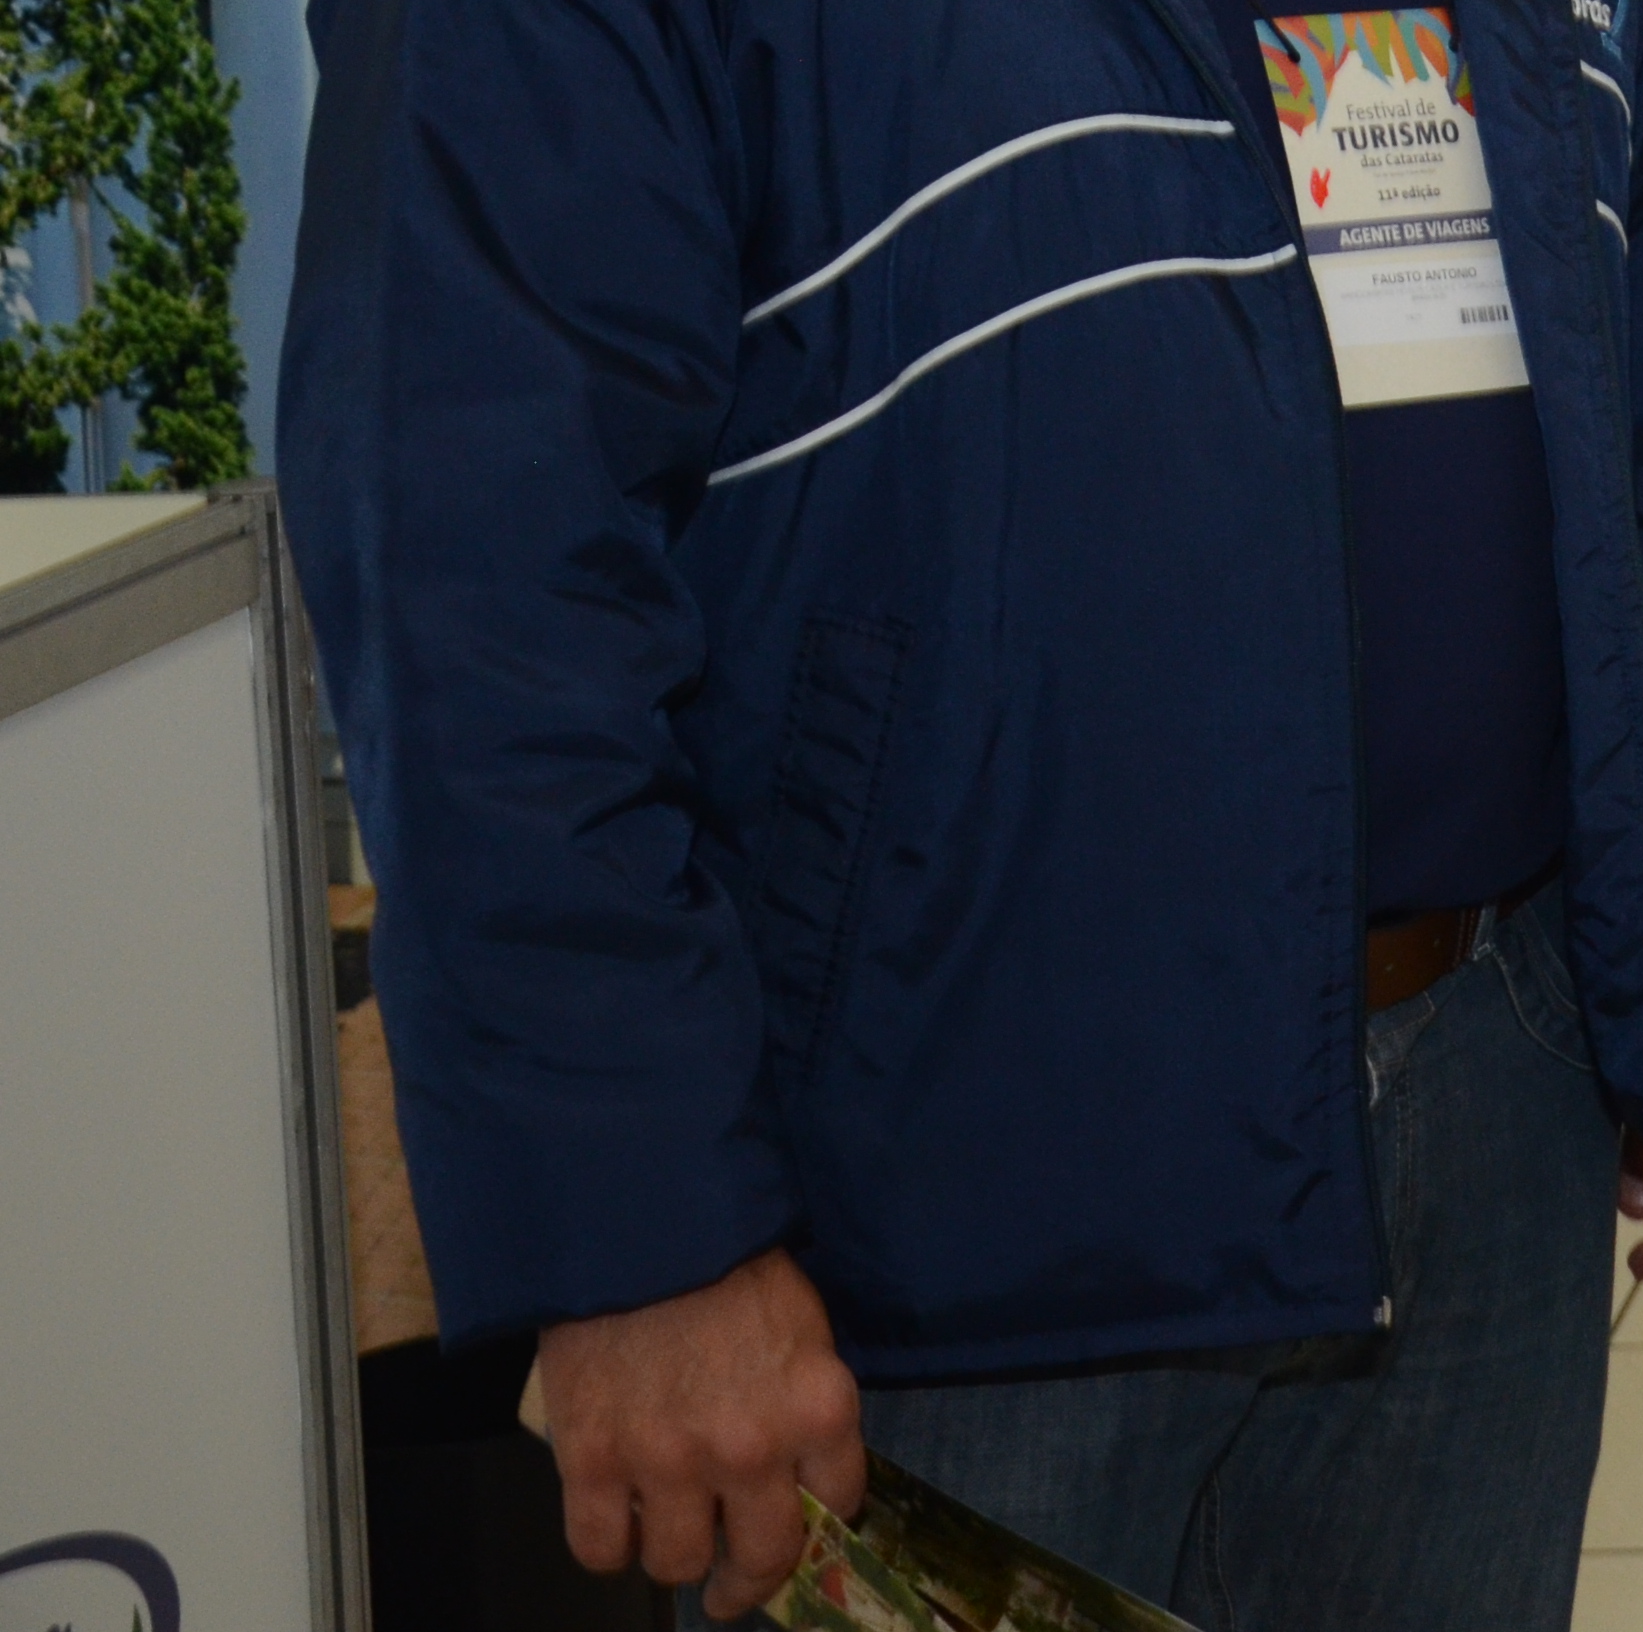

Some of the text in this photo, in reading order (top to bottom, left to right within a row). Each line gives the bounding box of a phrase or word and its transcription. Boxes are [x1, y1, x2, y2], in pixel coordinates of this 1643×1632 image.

[1346, 98, 1436, 121] Festival de
[1332, 118, 1460, 151] TURISMO
[1360, 151, 1443, 168] das Cataratas
[1402, 184, 1441, 201] edição
[1340, 217, 1490, 246] AGENTE DE VIAGENS
[1372, 266, 1477, 285] FAUSTO ANTONIO
